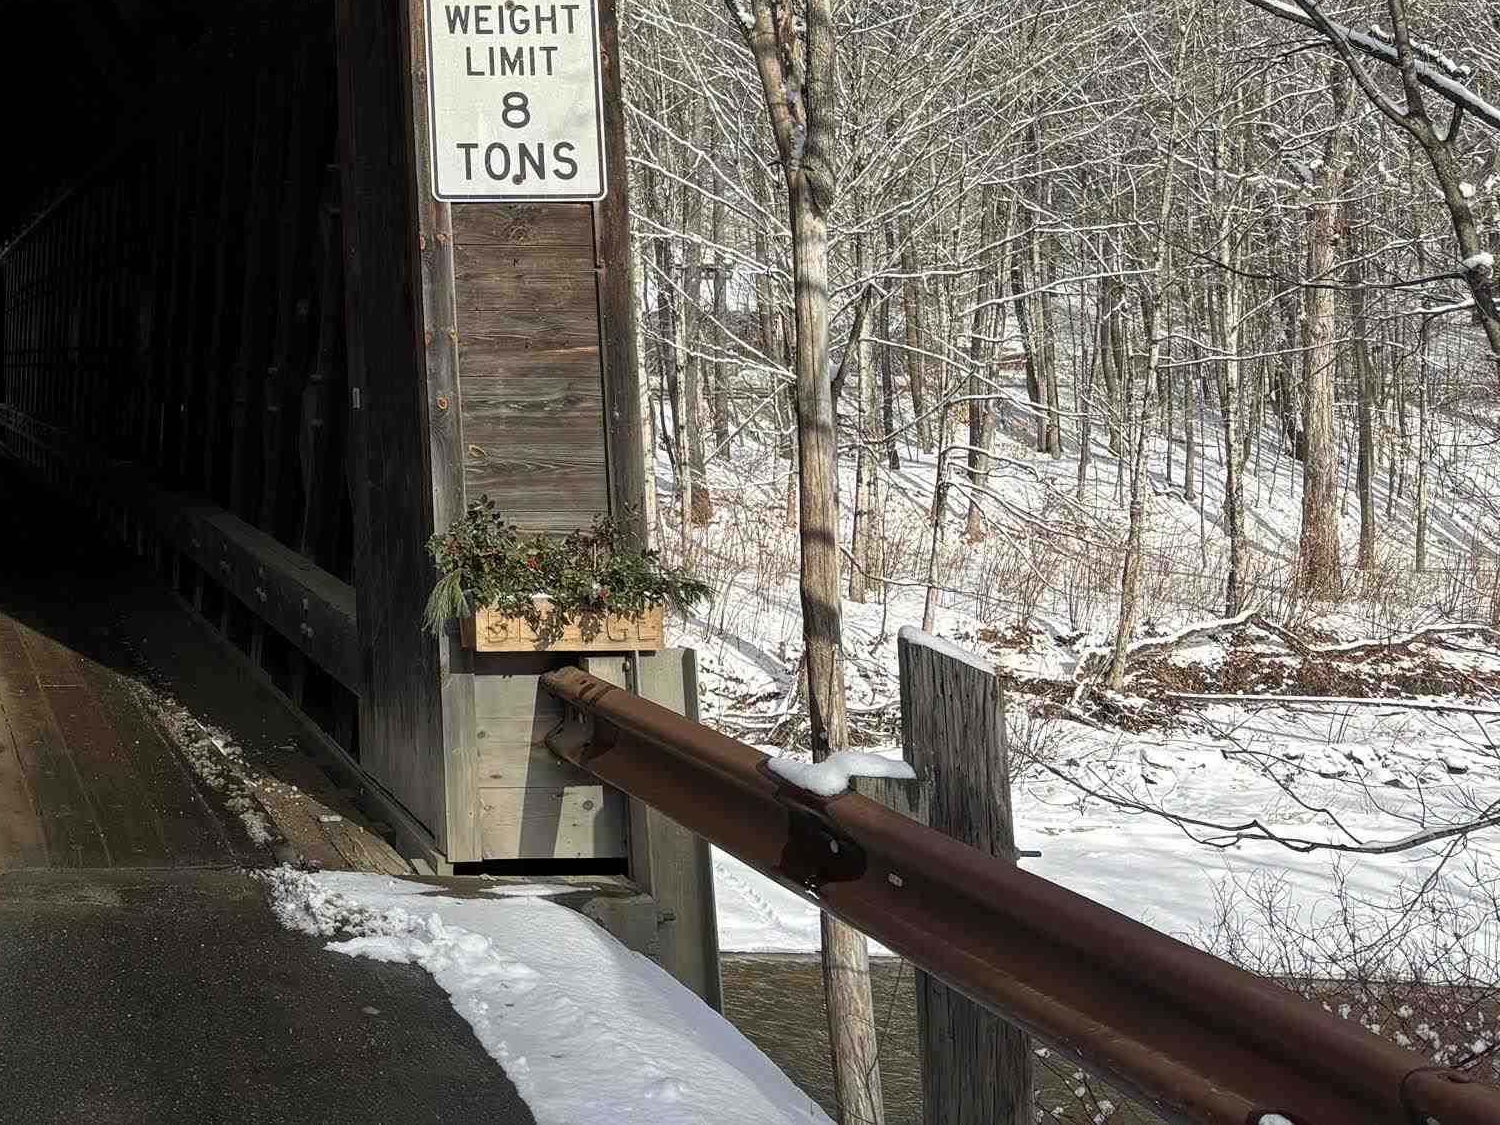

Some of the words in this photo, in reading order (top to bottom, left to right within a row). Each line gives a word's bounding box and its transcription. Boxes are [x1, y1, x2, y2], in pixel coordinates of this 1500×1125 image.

[445, 4, 580, 35] WEIGHT
[466, 46, 558, 76] LIMIT
[501, 91, 531, 129] 8
[456, 141, 579, 180] TONS
